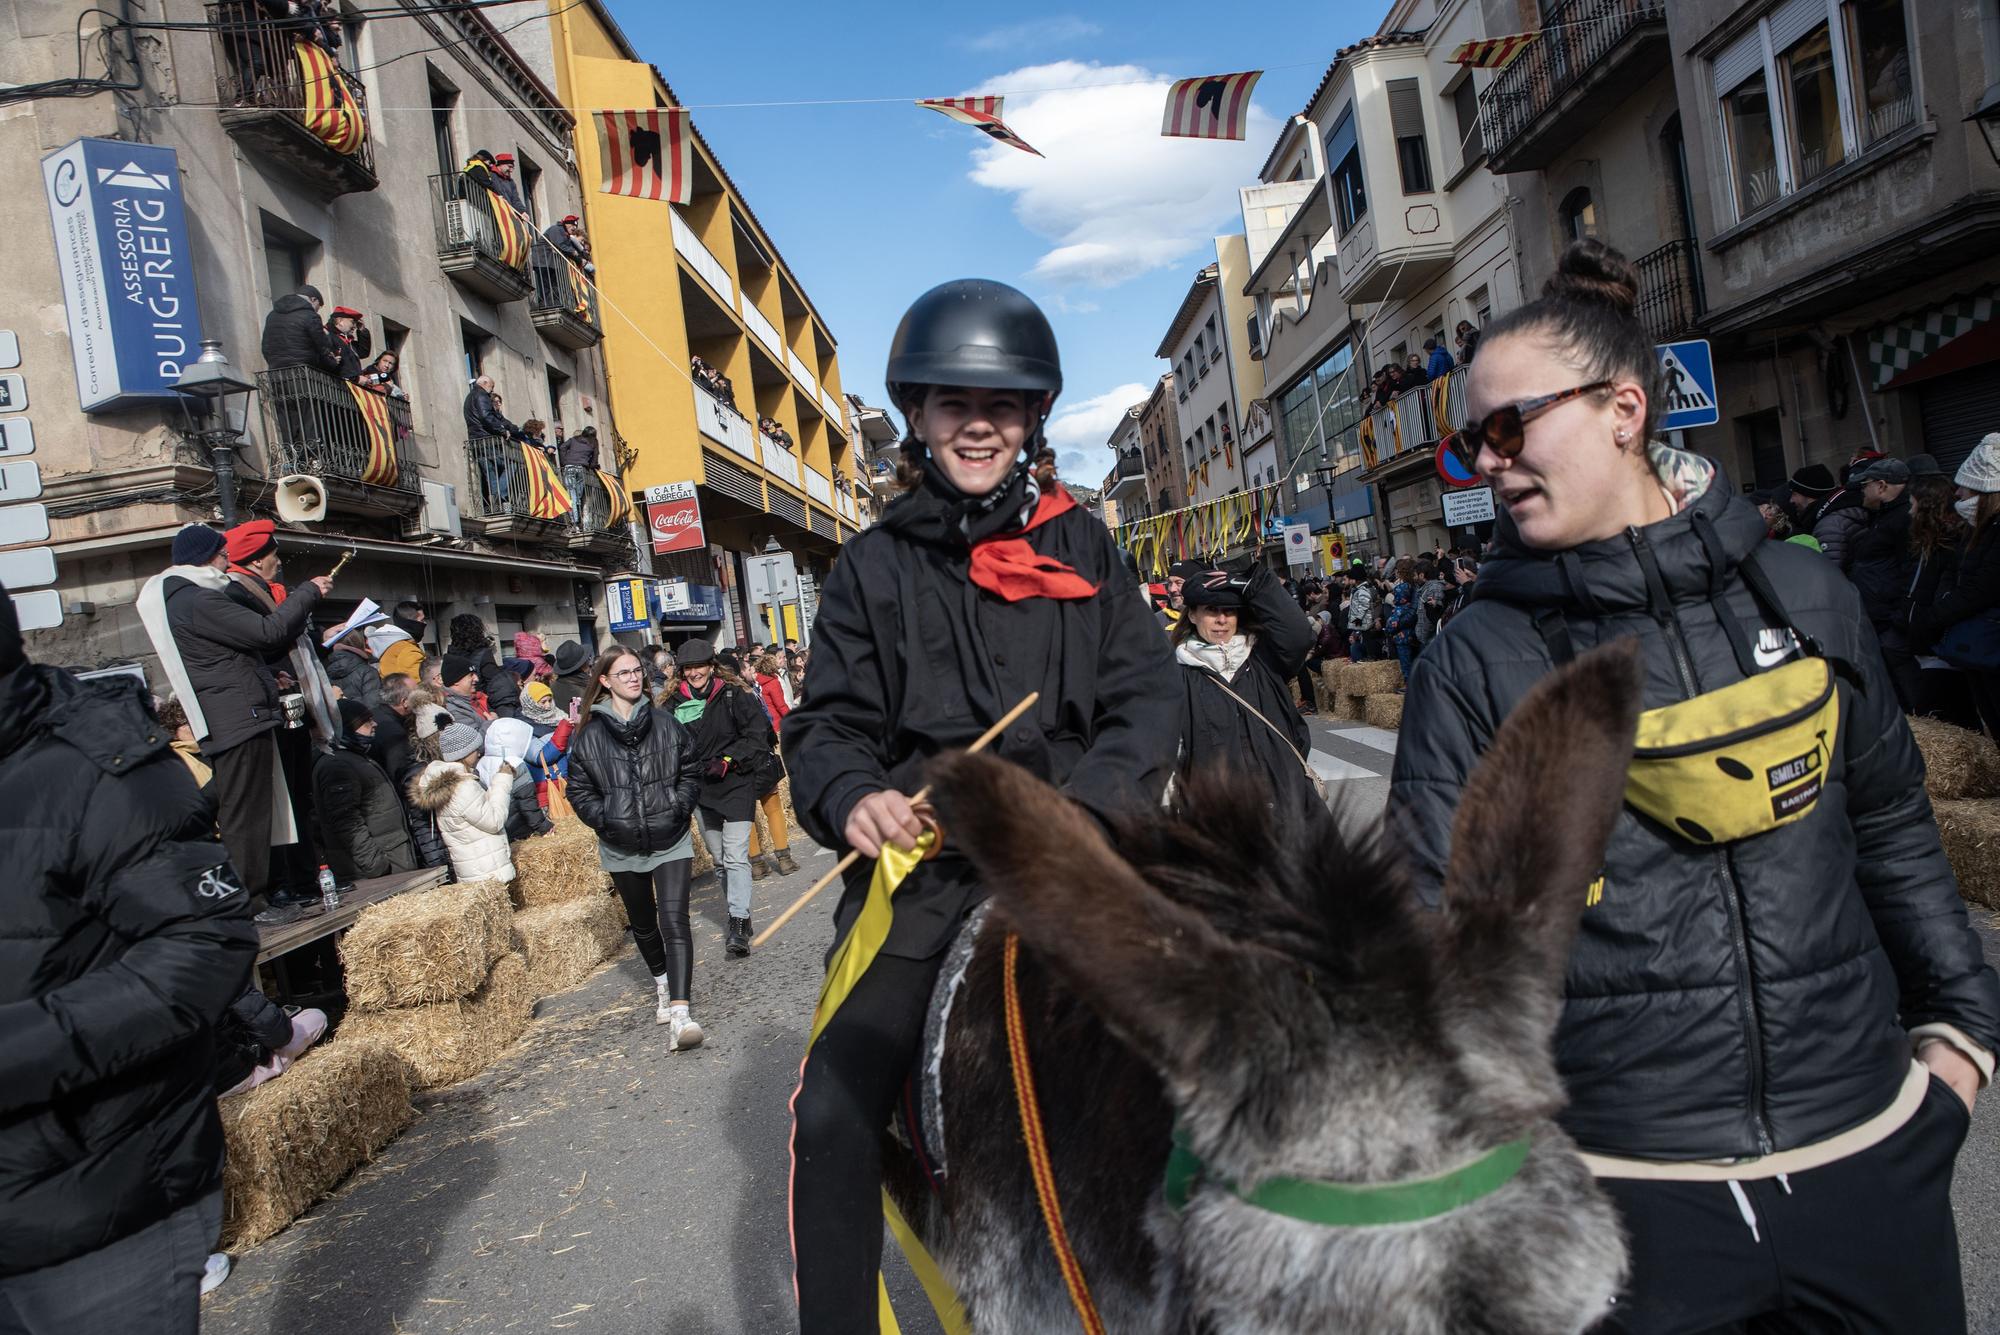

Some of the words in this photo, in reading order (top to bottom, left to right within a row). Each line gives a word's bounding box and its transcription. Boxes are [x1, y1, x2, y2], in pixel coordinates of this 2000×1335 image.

[66, 215, 90, 329] d'assegurances
[111, 197, 145, 305] ASSESSORIA
[133, 199, 187, 379] PUIG-REIG
[84, 332, 99, 396] Corredor
[646, 489, 693, 503] LLOBREGAT
[653, 483, 683, 495] CAFE
[1770, 757, 1807, 787] SMILEY
[1781, 783, 1818, 809] EASTPAK
